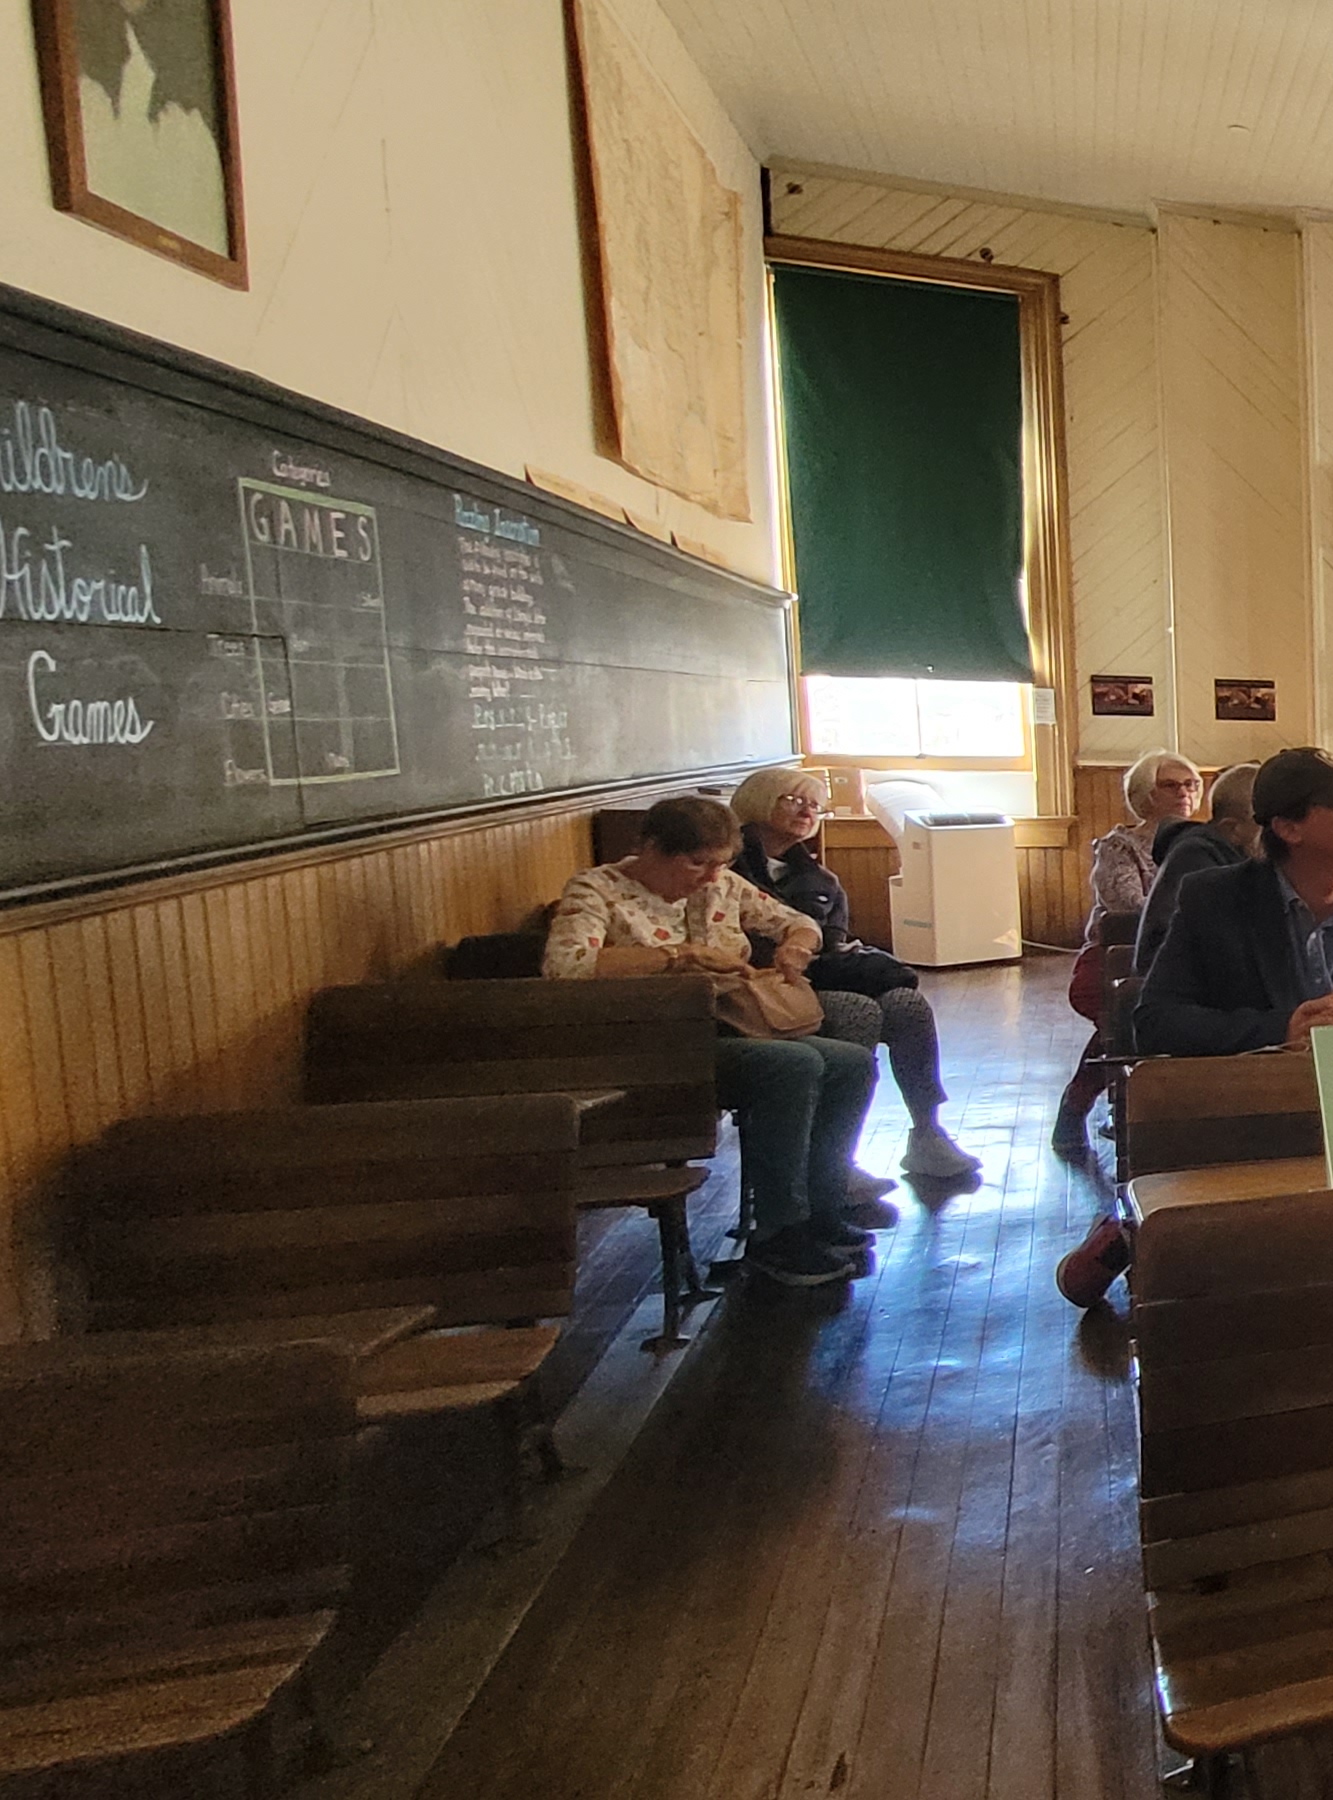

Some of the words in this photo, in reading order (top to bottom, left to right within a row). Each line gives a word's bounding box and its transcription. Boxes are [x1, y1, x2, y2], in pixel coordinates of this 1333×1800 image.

[0, 517, 162, 624] Historical
[250, 491, 373, 562] GAMES
[27, 650, 155, 744] Games
